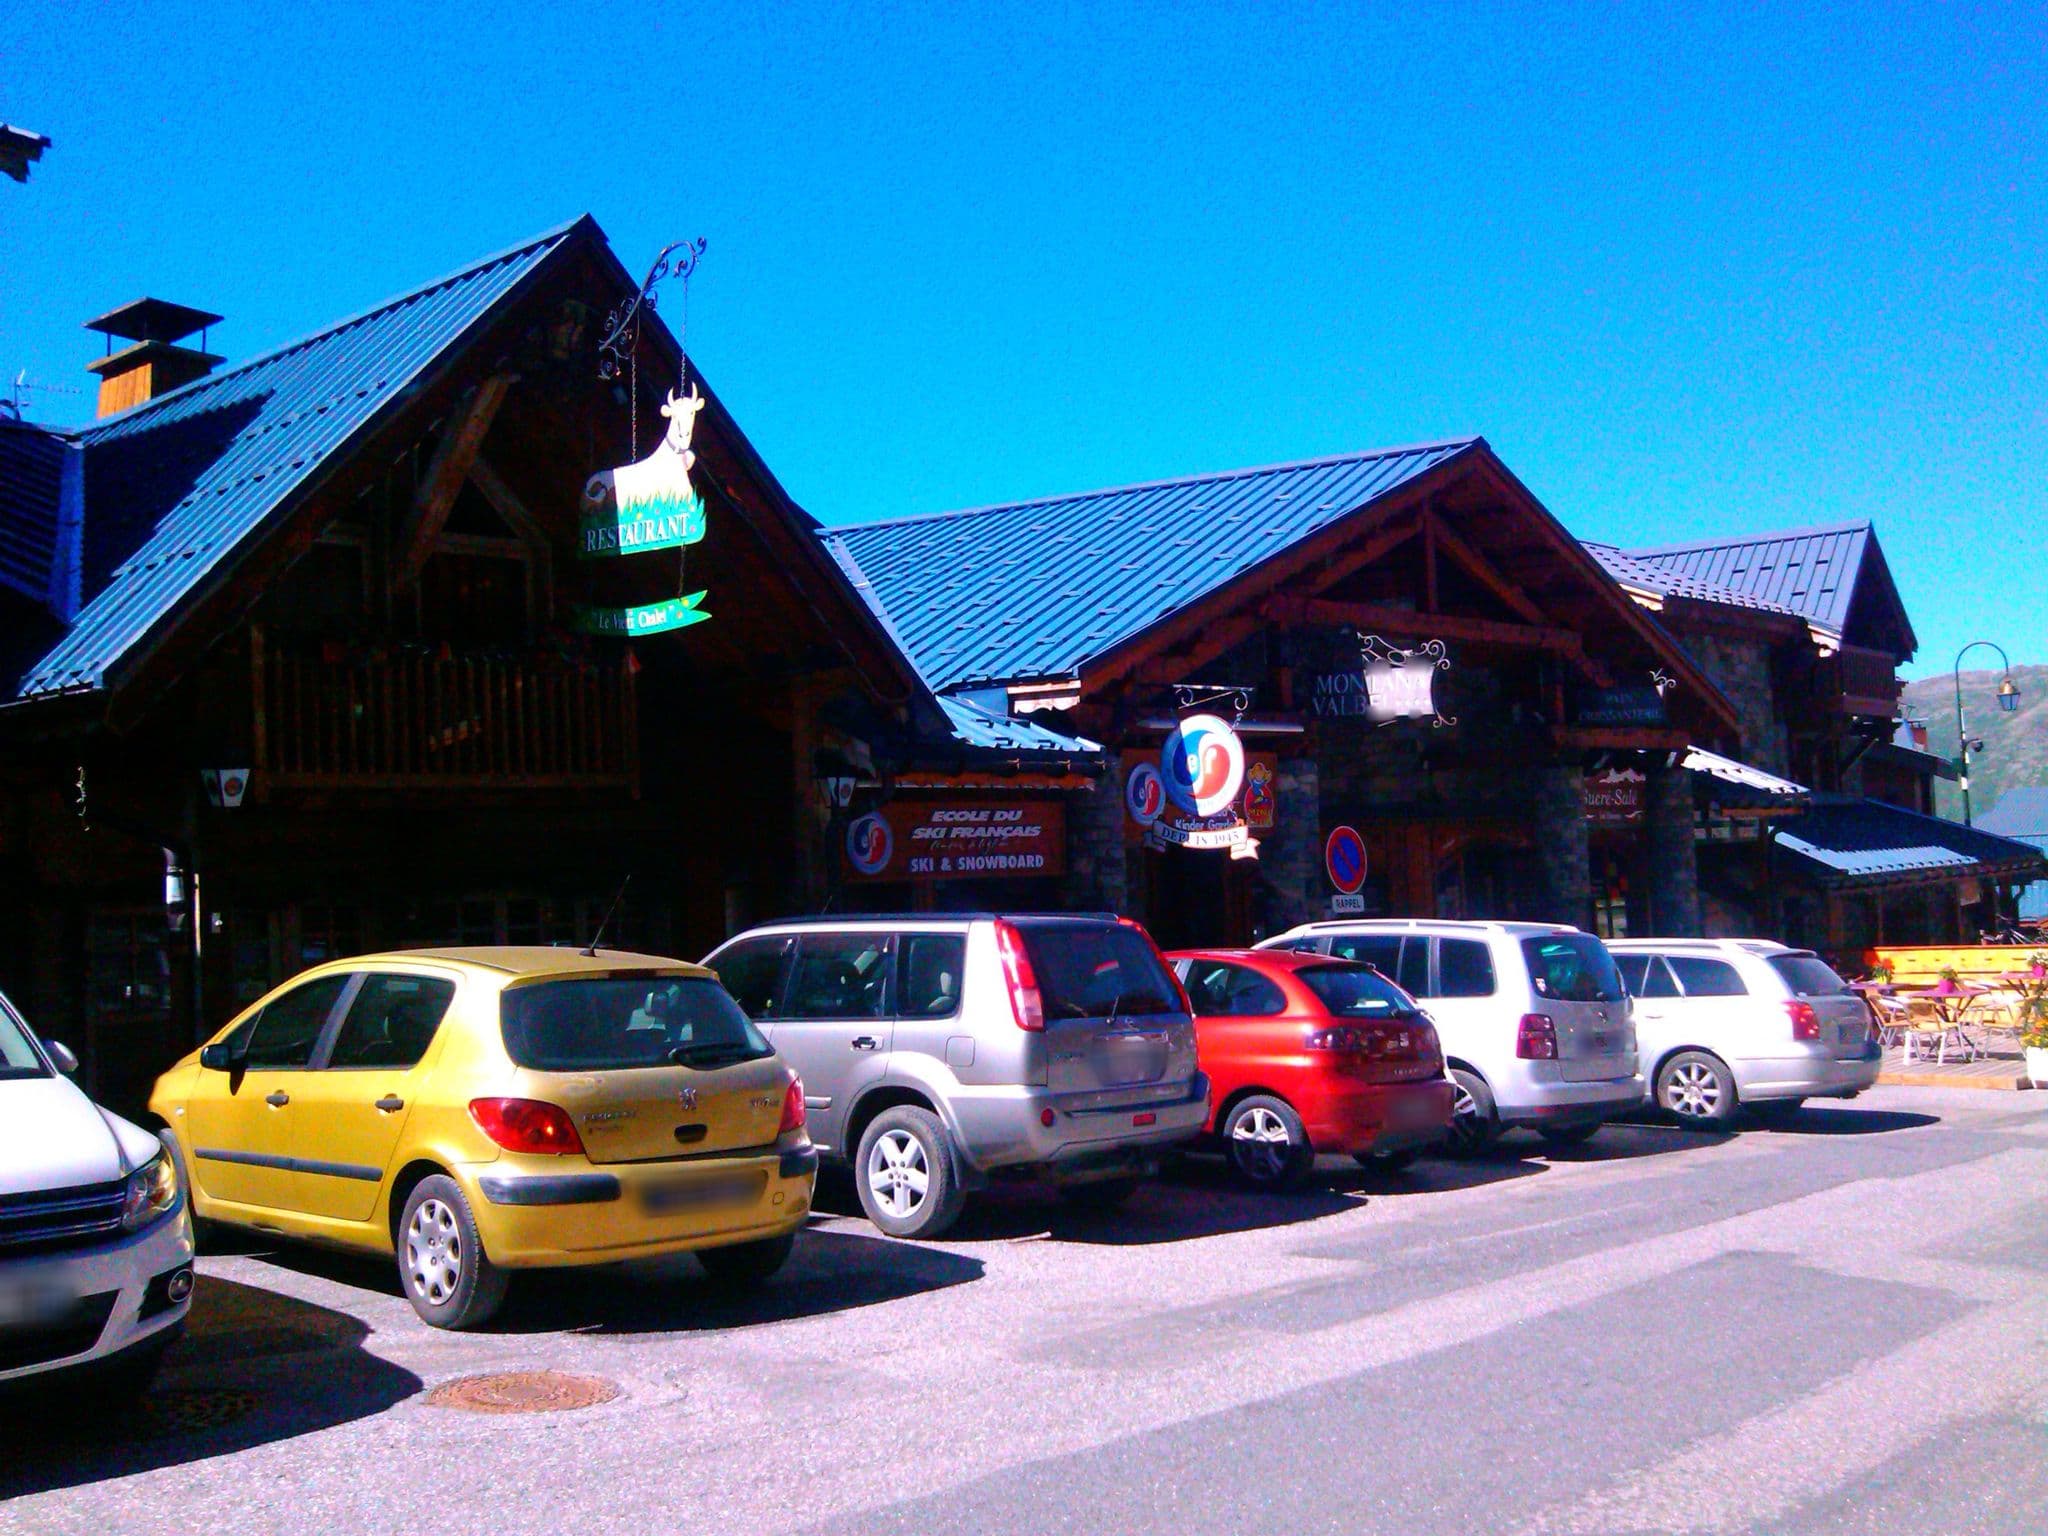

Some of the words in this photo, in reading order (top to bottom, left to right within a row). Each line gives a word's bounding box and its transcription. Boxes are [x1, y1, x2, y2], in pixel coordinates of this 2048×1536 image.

[587, 512, 690, 552] RESTAURANT
[932, 810, 991, 822] ECOLE
[993, 810, 1023, 822] DU
[911, 827, 948, 839] SKI
[949, 826, 1042, 839] FRANÇAIS
[1174, 818, 1205, 833] Kinder
[911, 857, 935, 872] SKI
[940, 857, 952, 871] &
[958, 854, 1045, 870] SNOWBOARD
